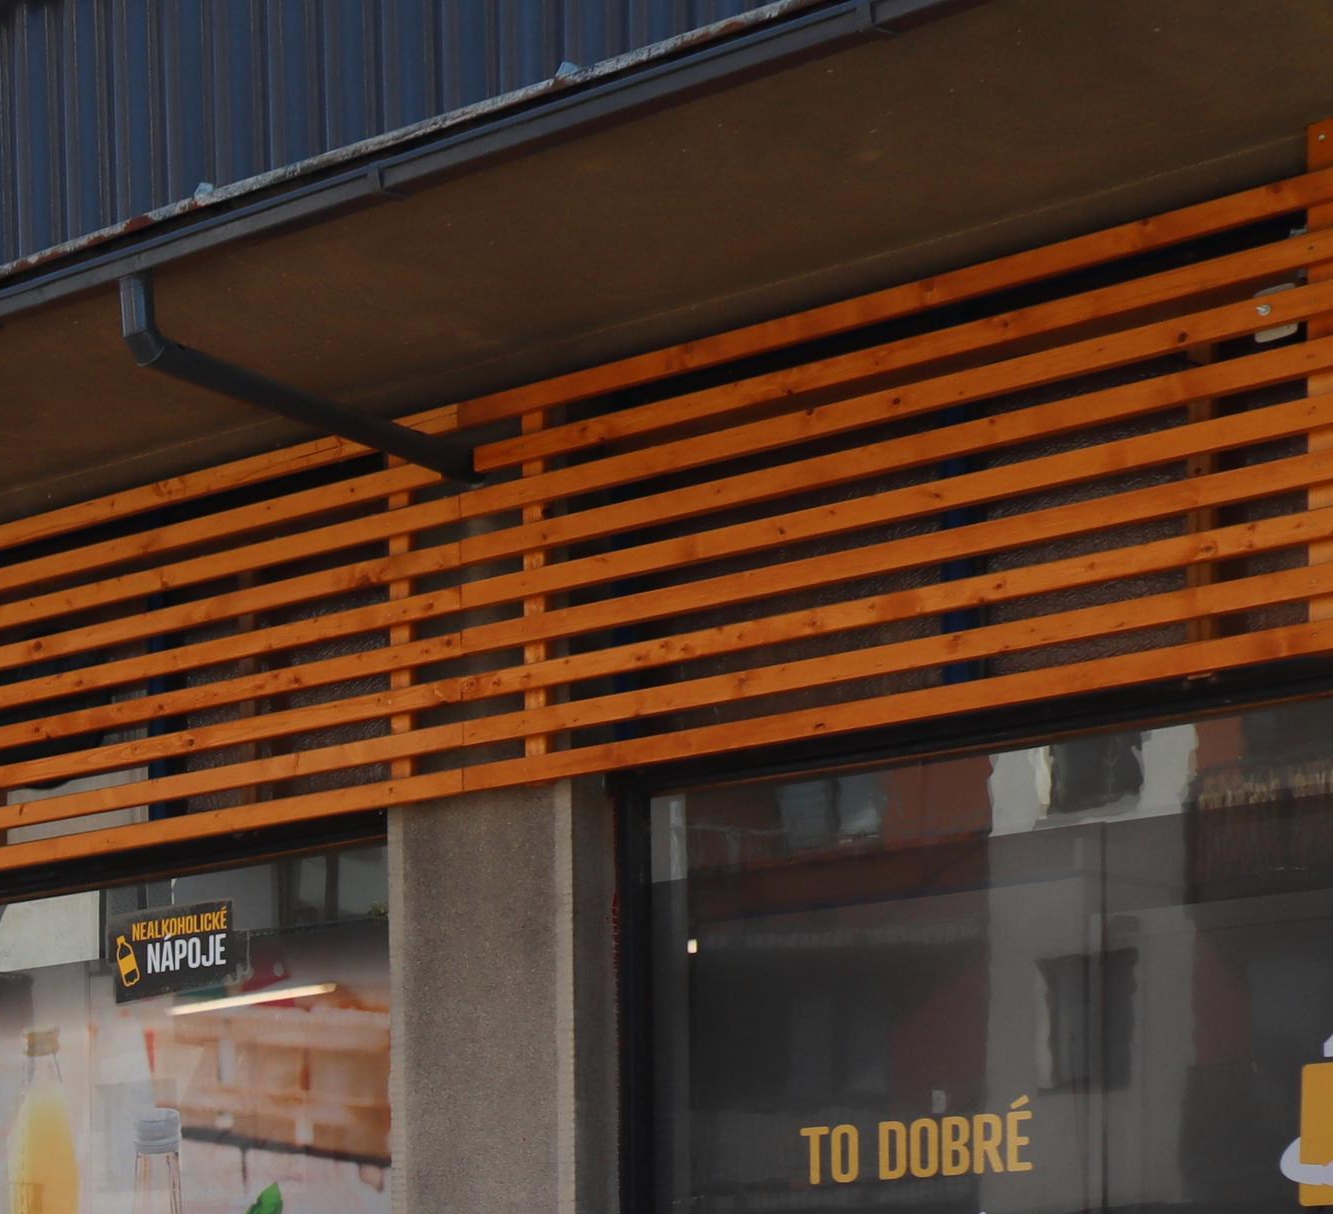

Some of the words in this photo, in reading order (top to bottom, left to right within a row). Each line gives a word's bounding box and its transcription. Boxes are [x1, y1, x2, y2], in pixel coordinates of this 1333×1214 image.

[132, 906, 228, 941] NEALKOHOLICKÉ
[147, 933, 227, 974] NÁPOJE
[800, 1124, 860, 1185] TO
[878, 1094, 1034, 1180] DOBRÉ
